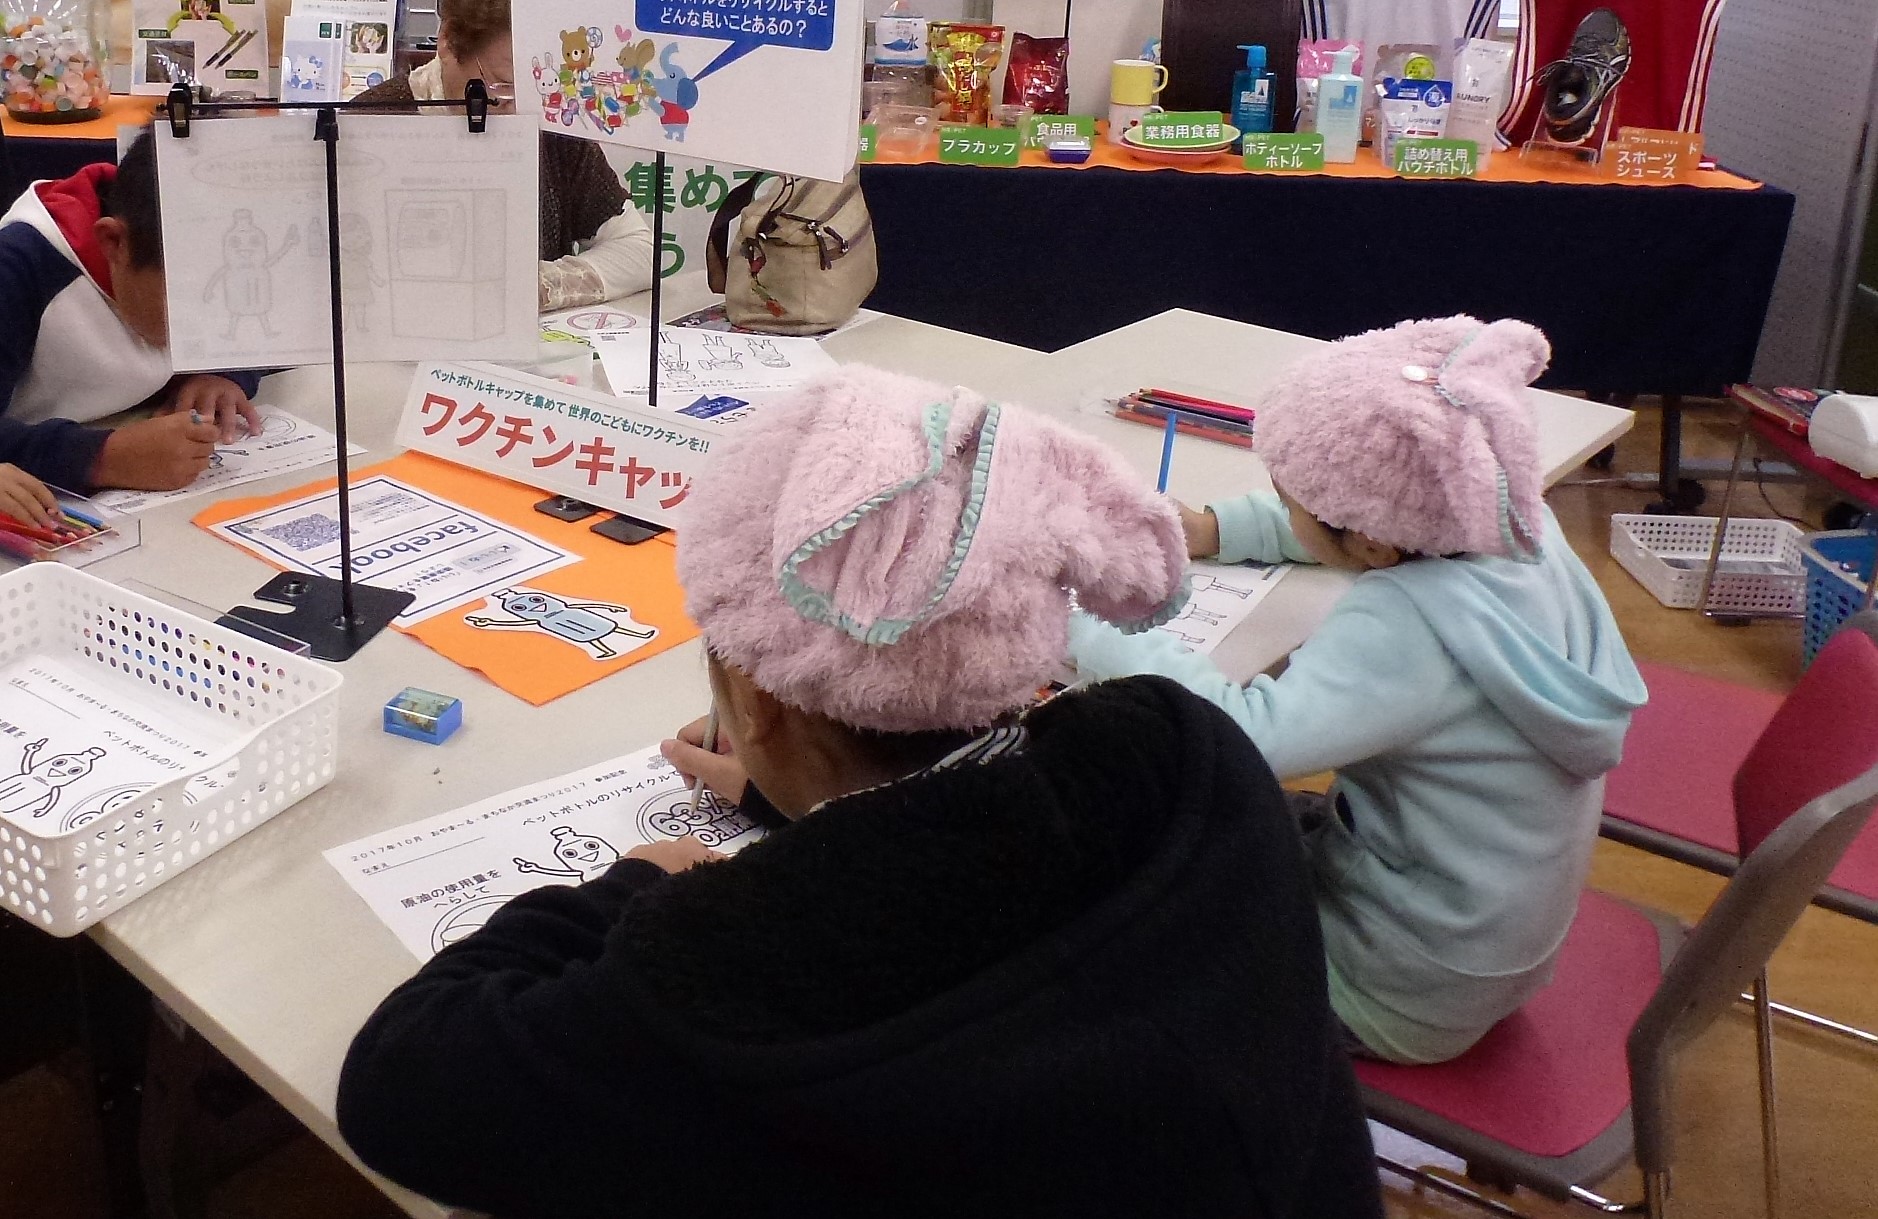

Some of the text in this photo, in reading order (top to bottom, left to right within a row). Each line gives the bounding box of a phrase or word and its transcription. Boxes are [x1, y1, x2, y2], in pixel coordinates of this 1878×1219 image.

[660, 7, 807, 38] どんな良いことあるの？
[1037, 122, 1077, 136] 食品用
[1145, 124, 1220, 140] 業務用食器
[1404, 147, 1468, 163] 詰め替え用
[1617, 151, 1677, 165] スポーツ
[1617, 165, 1675, 178] シューズ
[430, 368, 567, 415] ペットボトルキャップを集めて
[400, 869, 502, 909] 原油の使用量を
[433, 885, 490, 909] へらして
